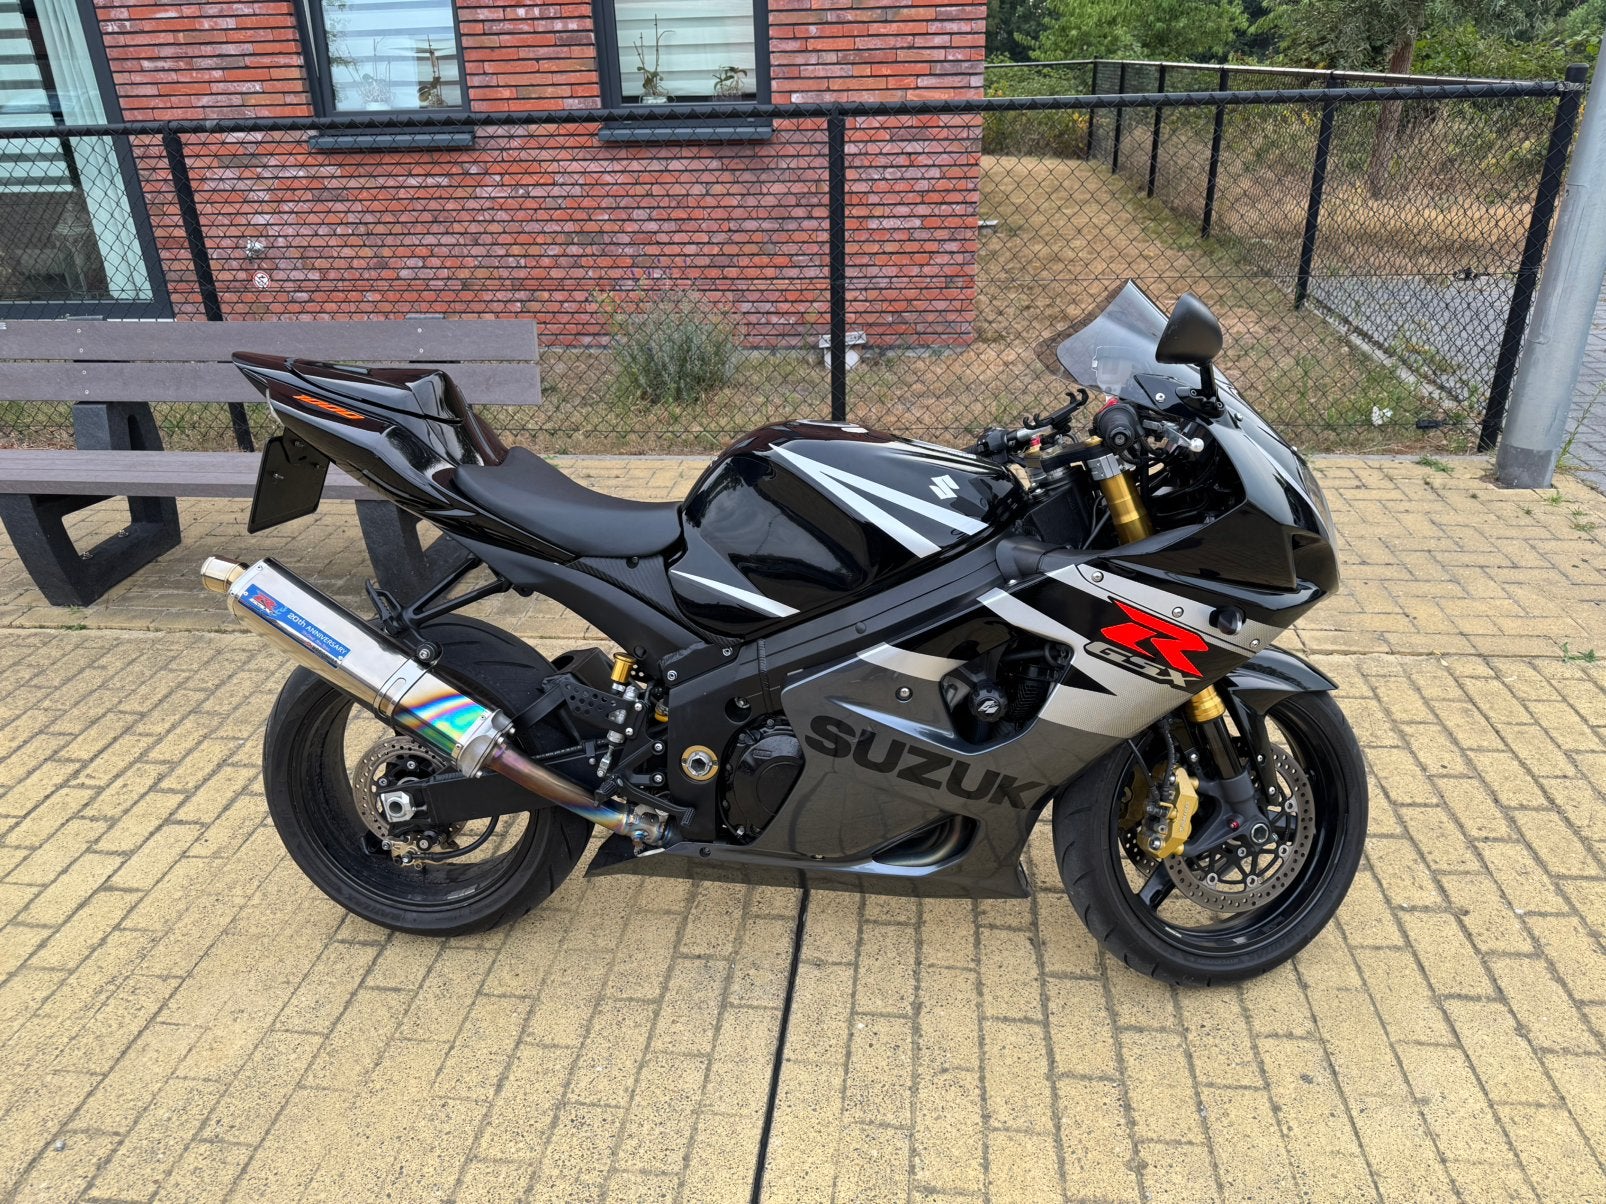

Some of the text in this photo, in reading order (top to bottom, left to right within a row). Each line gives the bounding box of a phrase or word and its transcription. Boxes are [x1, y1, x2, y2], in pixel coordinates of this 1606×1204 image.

[286, 611, 306, 628] 20th
[305, 625, 348, 655] ANNIVERSARY
[1085, 641, 1203, 689] GSX
